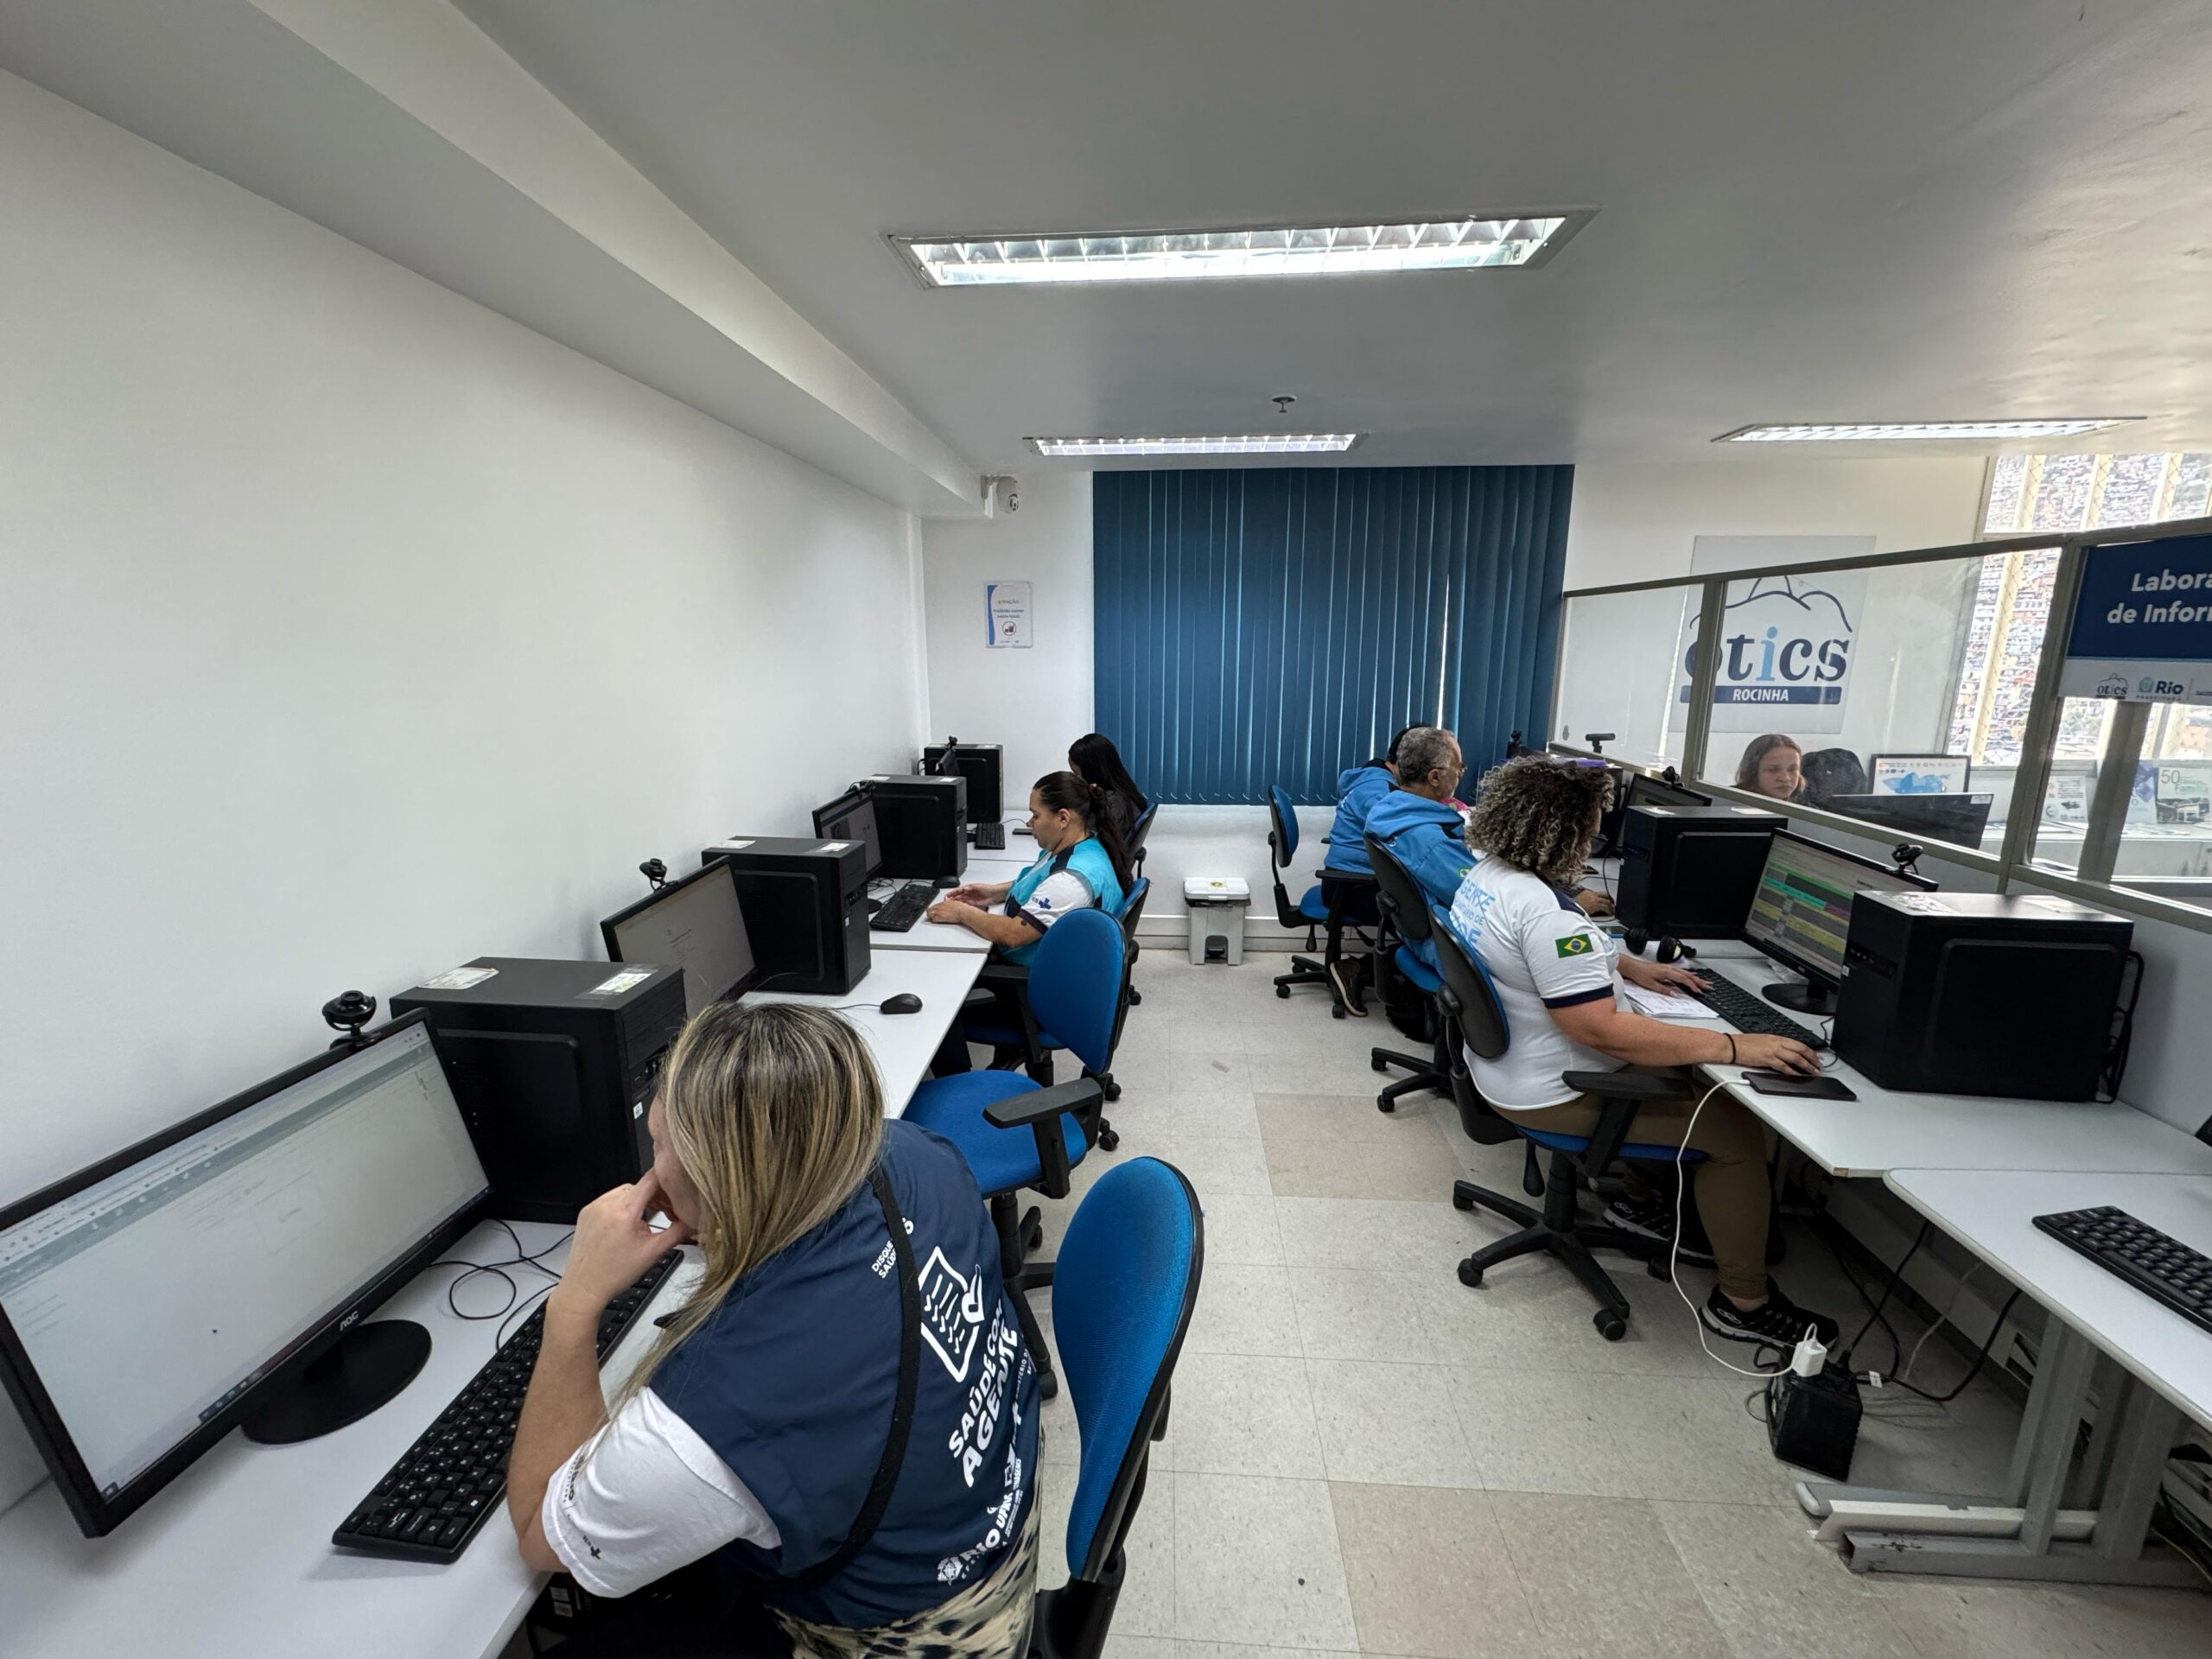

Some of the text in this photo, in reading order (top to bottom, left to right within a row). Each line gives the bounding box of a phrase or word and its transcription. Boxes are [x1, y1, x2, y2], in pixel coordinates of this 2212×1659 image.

[2107, 600, 2212, 623] de Infor
[1732, 689, 1789, 701] ROCINHA
[2097, 684, 2128, 695] otics
[2155, 680, 2184, 695] Rio
[2161, 770, 2180, 784] 50
[871, 1240, 893, 1273] DISQUE
[340, 1310, 359, 1332] AOC
[949, 1353, 996, 1459] SAÚDE
[962, 1318, 1018, 1488] AGENTE
